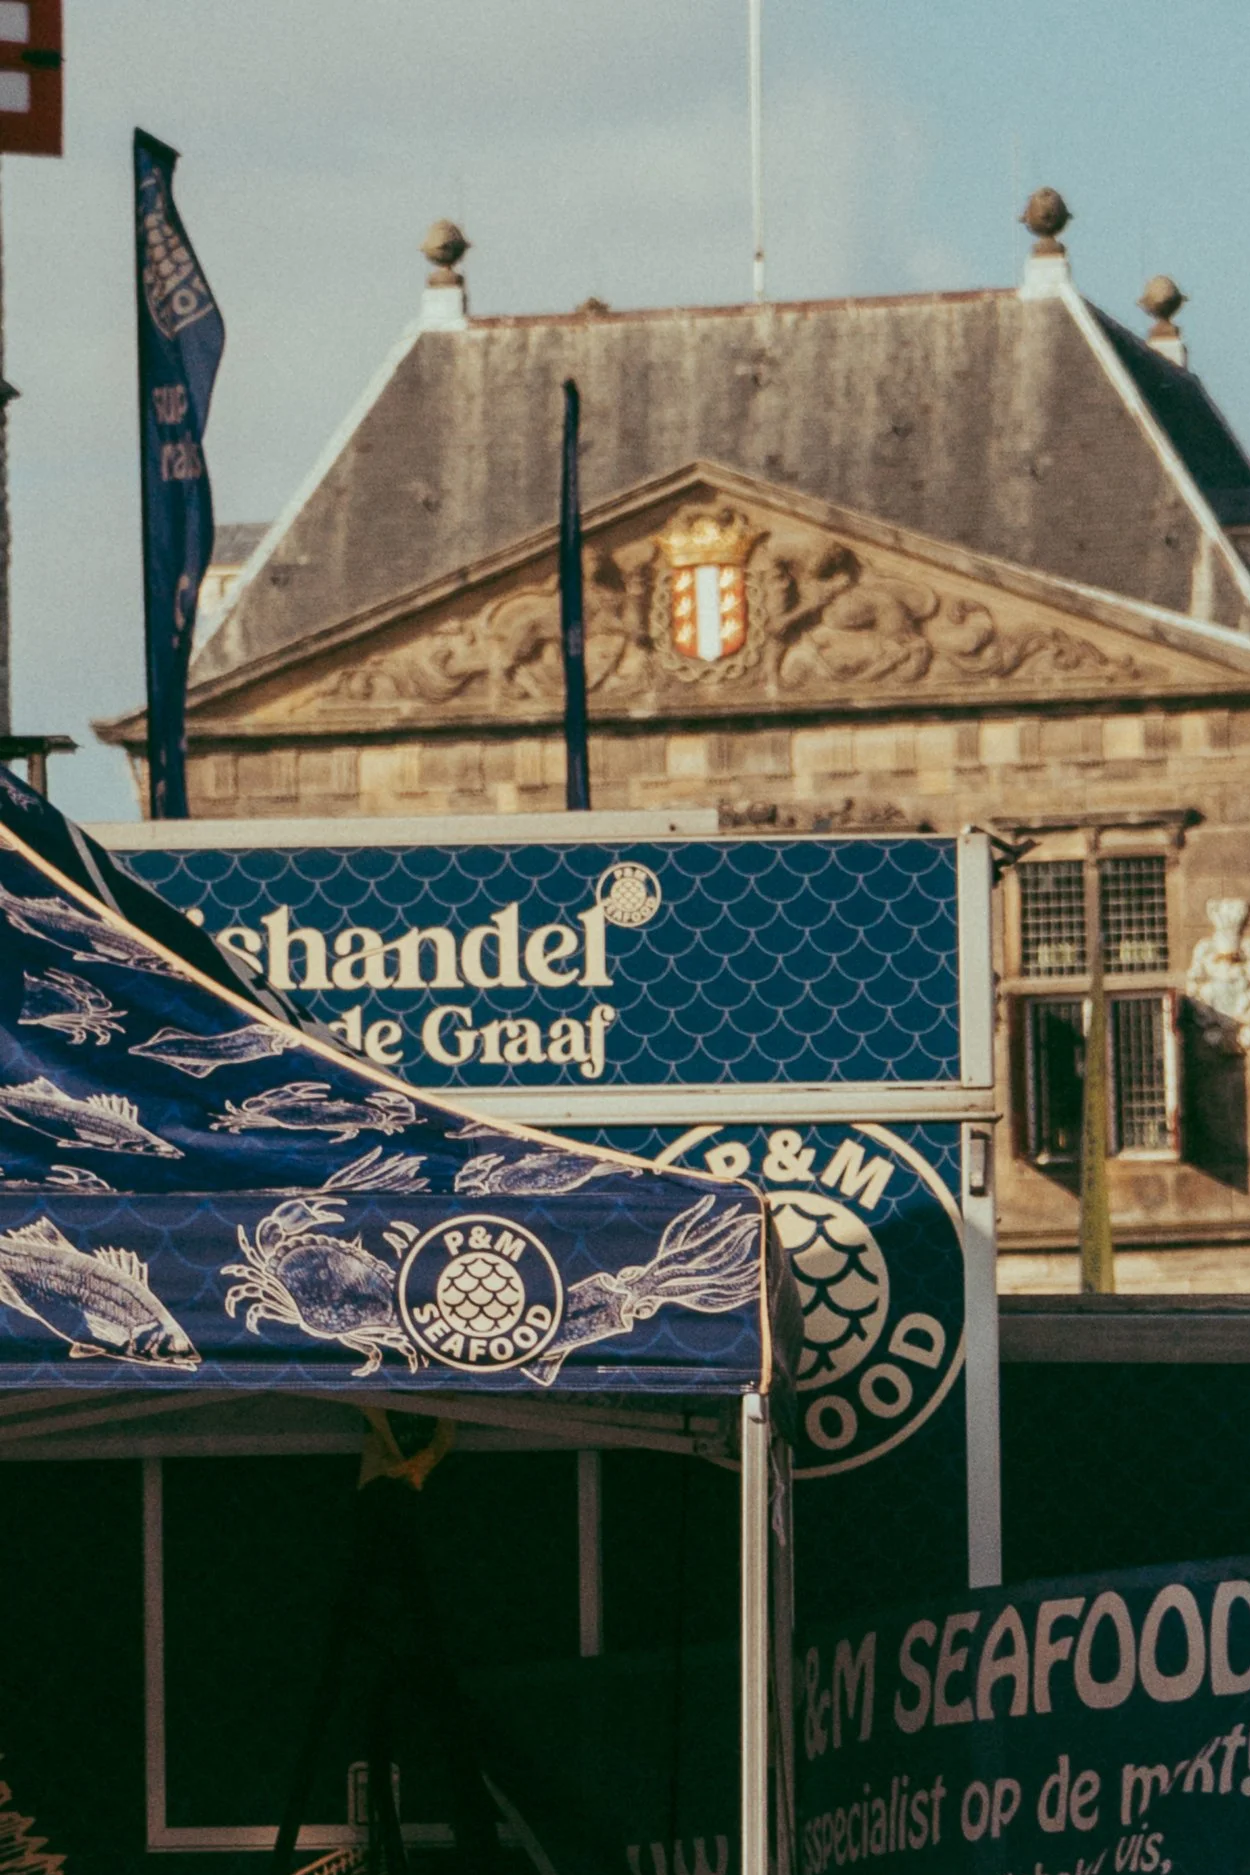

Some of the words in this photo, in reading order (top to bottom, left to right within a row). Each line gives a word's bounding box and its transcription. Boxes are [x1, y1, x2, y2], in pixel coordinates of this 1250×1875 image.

[186, 903, 614, 991] shandel
[422, 1004, 616, 1080] Graaf
[704, 1129, 896, 1211] P&M
[443, 1225, 527, 1263] P&M
[412, 1302, 552, 1362] SEAFOOD
[804, 1631, 877, 1762] &M
[960, 1777, 1022, 1842] op
[1036, 1753, 1101, 1833] de
[1114, 1821, 1172, 1875] vis,
